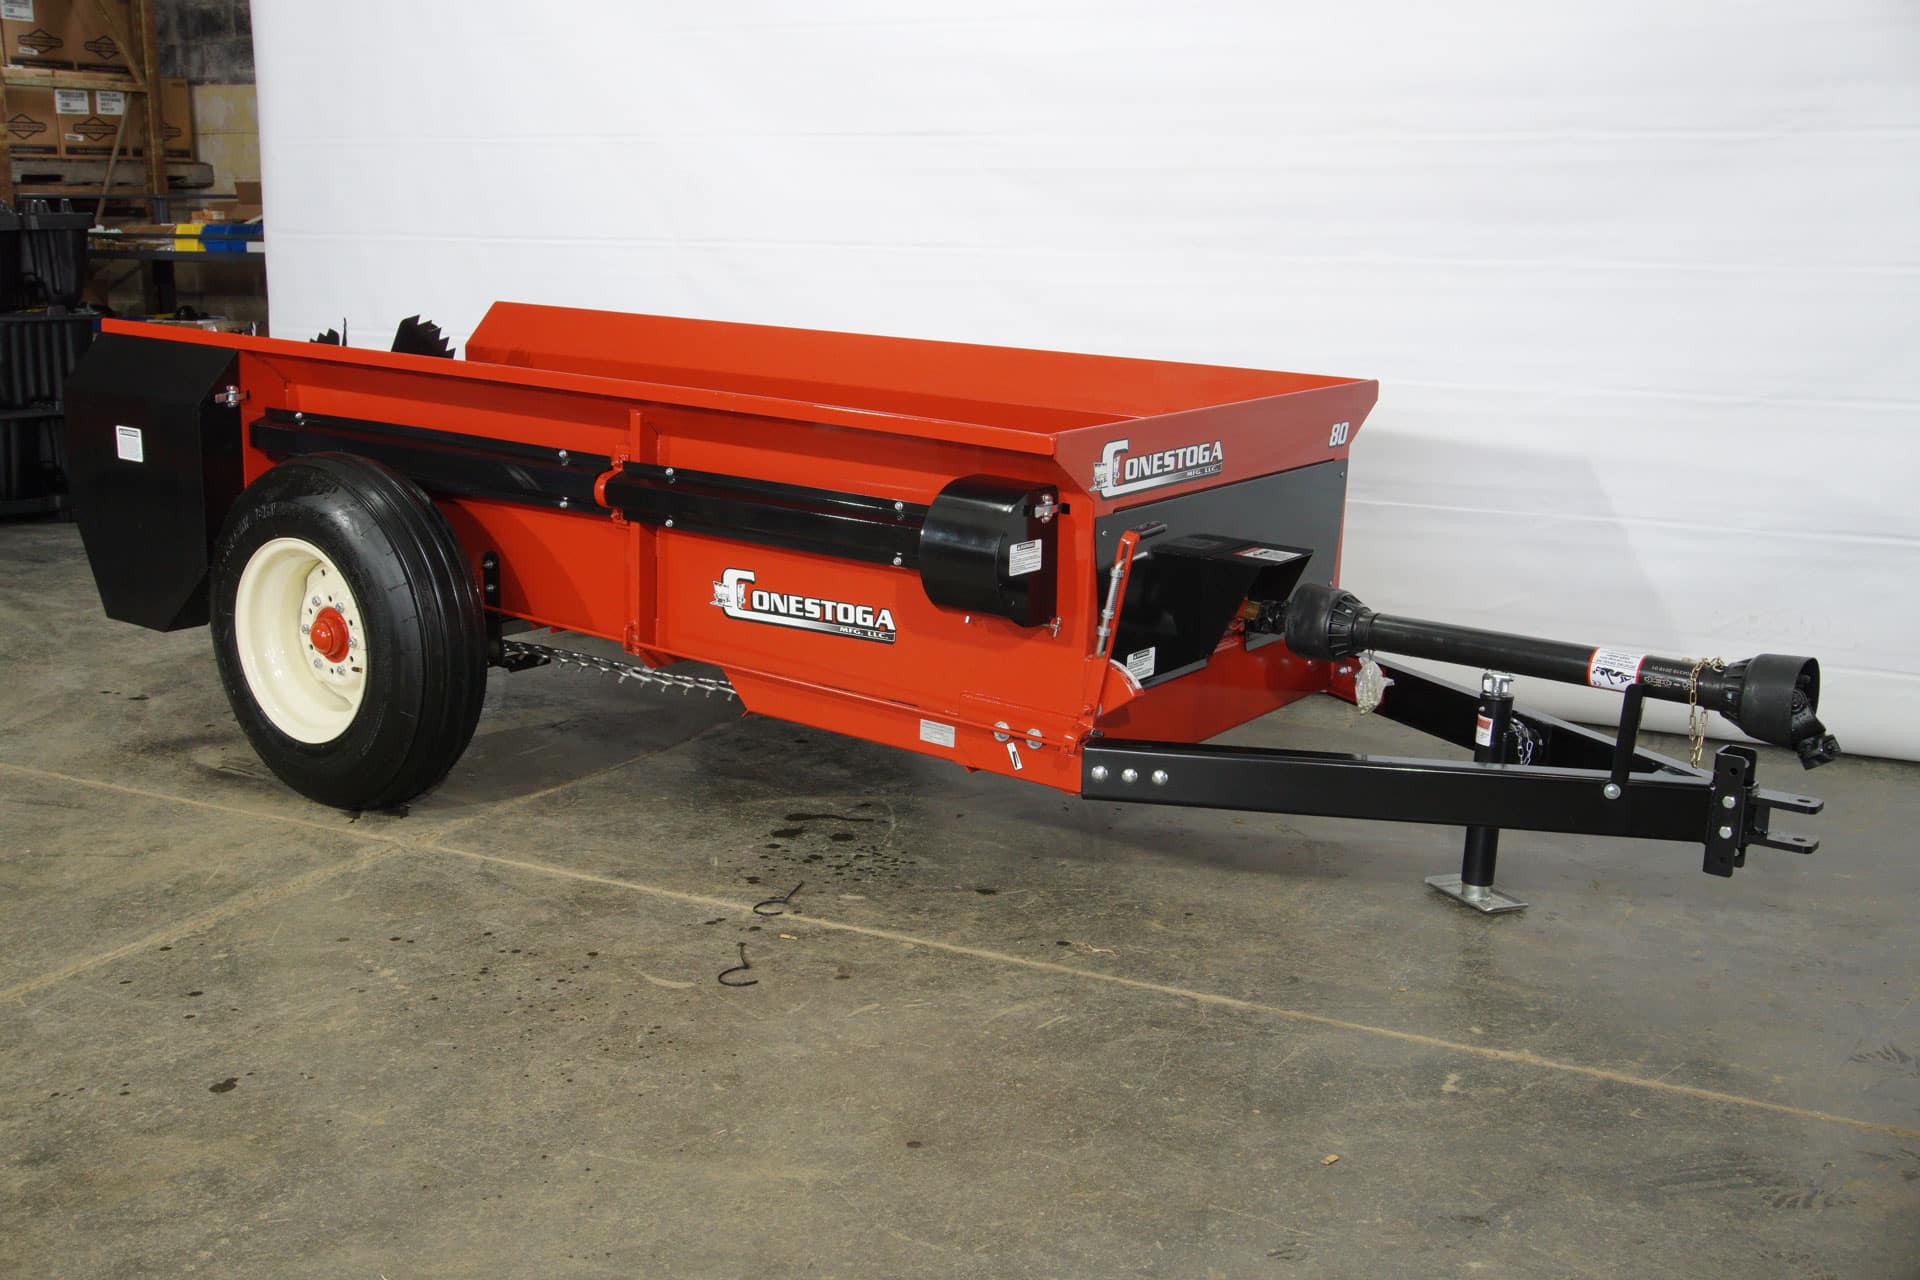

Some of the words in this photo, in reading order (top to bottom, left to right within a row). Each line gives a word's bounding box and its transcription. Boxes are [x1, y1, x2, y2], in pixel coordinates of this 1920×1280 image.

[1329, 421, 1349, 447] 80
[1102, 439, 1223, 497] CONESTOGA
[723, 568, 896, 631] CONESTOGA
[839, 626, 863, 636] MFG.
